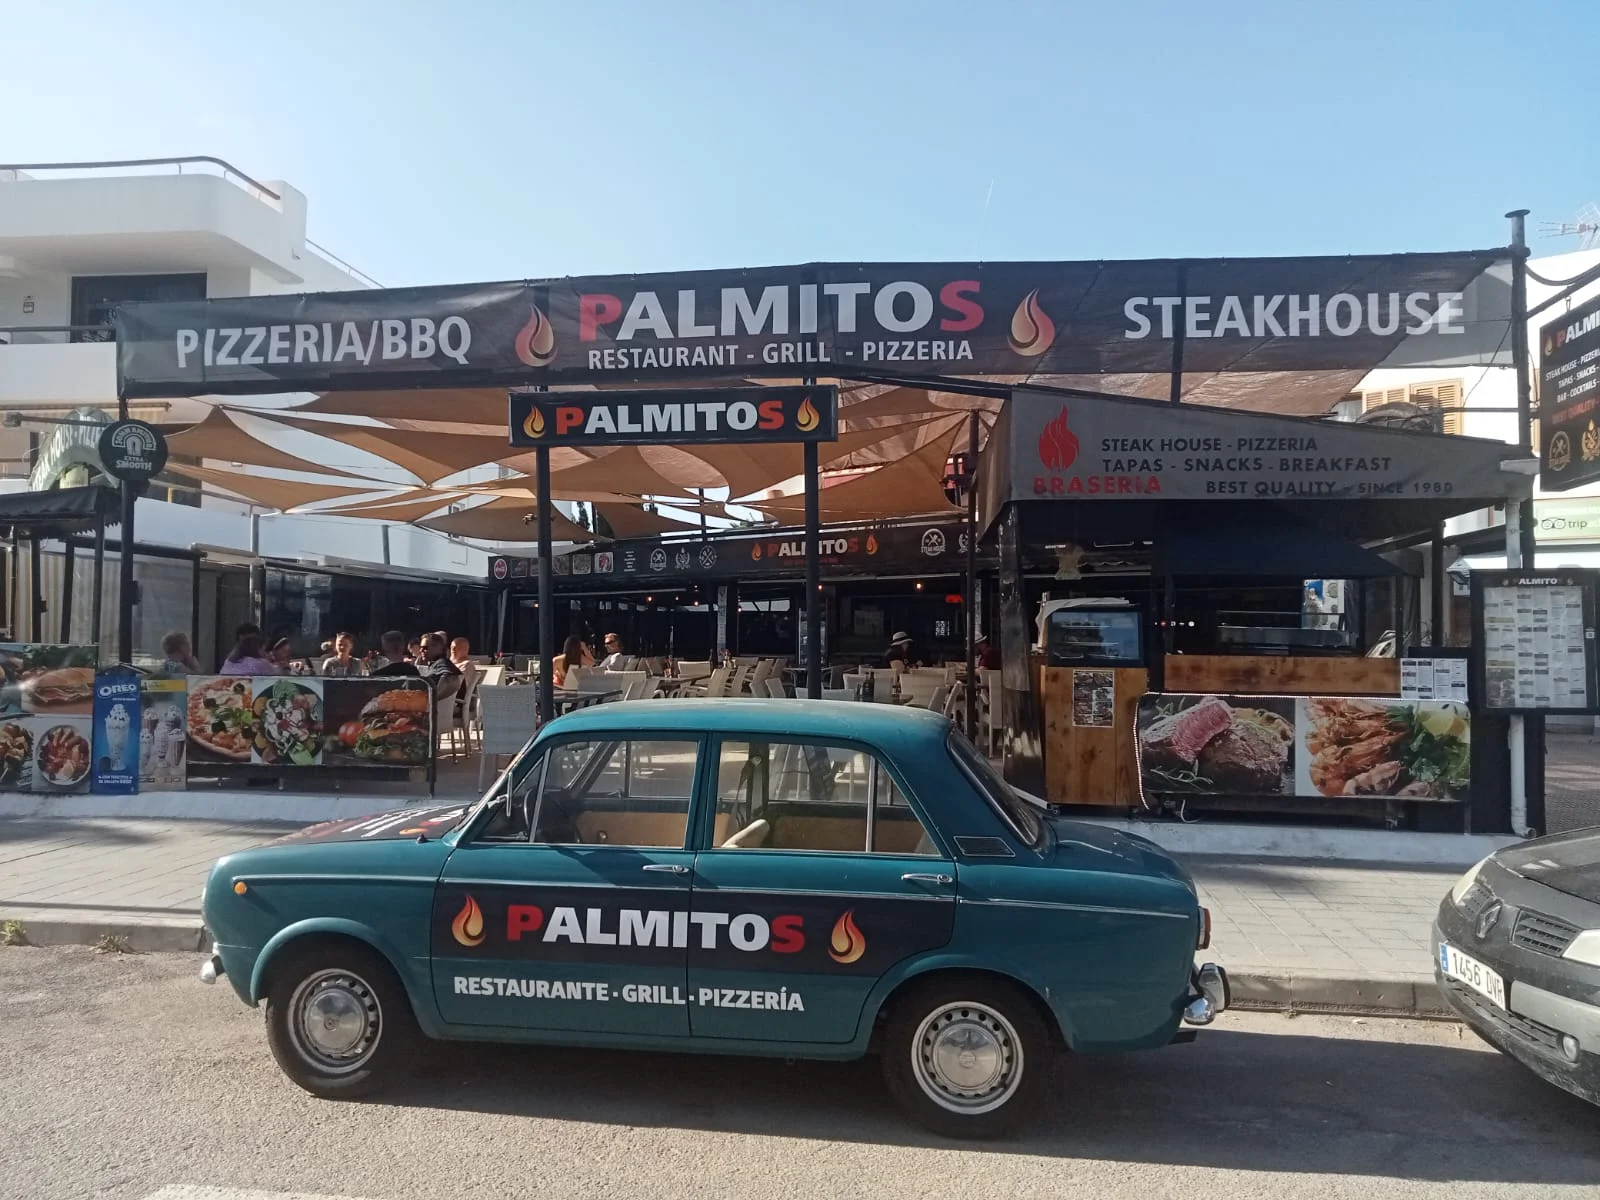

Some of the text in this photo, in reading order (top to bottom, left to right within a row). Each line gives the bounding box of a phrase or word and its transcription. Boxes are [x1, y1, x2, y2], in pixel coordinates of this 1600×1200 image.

[579, 280, 985, 342] PALMITOS
[1123, 292, 1465, 339] STEAKHOUSE
[176, 315, 472, 368] PIZZERIA/BBQ
[588, 344, 739, 370] RESTAURANT
[762, 341, 831, 364] GRILL
[863, 339, 974, 361] PIZZERIA
[555, 400, 784, 435] PALMITOS
[1101, 438, 1154, 451] STEAK
[1160, 438, 1222, 451] HOUSE
[1237, 437, 1318, 451] PIZZERIA
[116, 459, 153, 471] SMOOTH
[1102, 458, 1164, 472] TAPAS
[1184, 457, 1263, 472] SNACKS
[1279, 457, 1392, 472] BREAKFAST
[1033, 475, 1162, 495] BRASERIA
[1206, 481, 1249, 494] BEST
[1254, 481, 1337, 497] QUALITY
[1358, 482, 1404, 494] SINCE
[767, 538, 859, 558] PALITOS
[99, 683, 137, 697] OREO
[506, 903, 806, 954] PALMITOS
[1452, 952, 1481, 986] 1456
[454, 976, 609, 1002] RESTAURANTE
[622, 984, 686, 1005] GRILL
[698, 986, 805, 1011] PIZZERÍA
